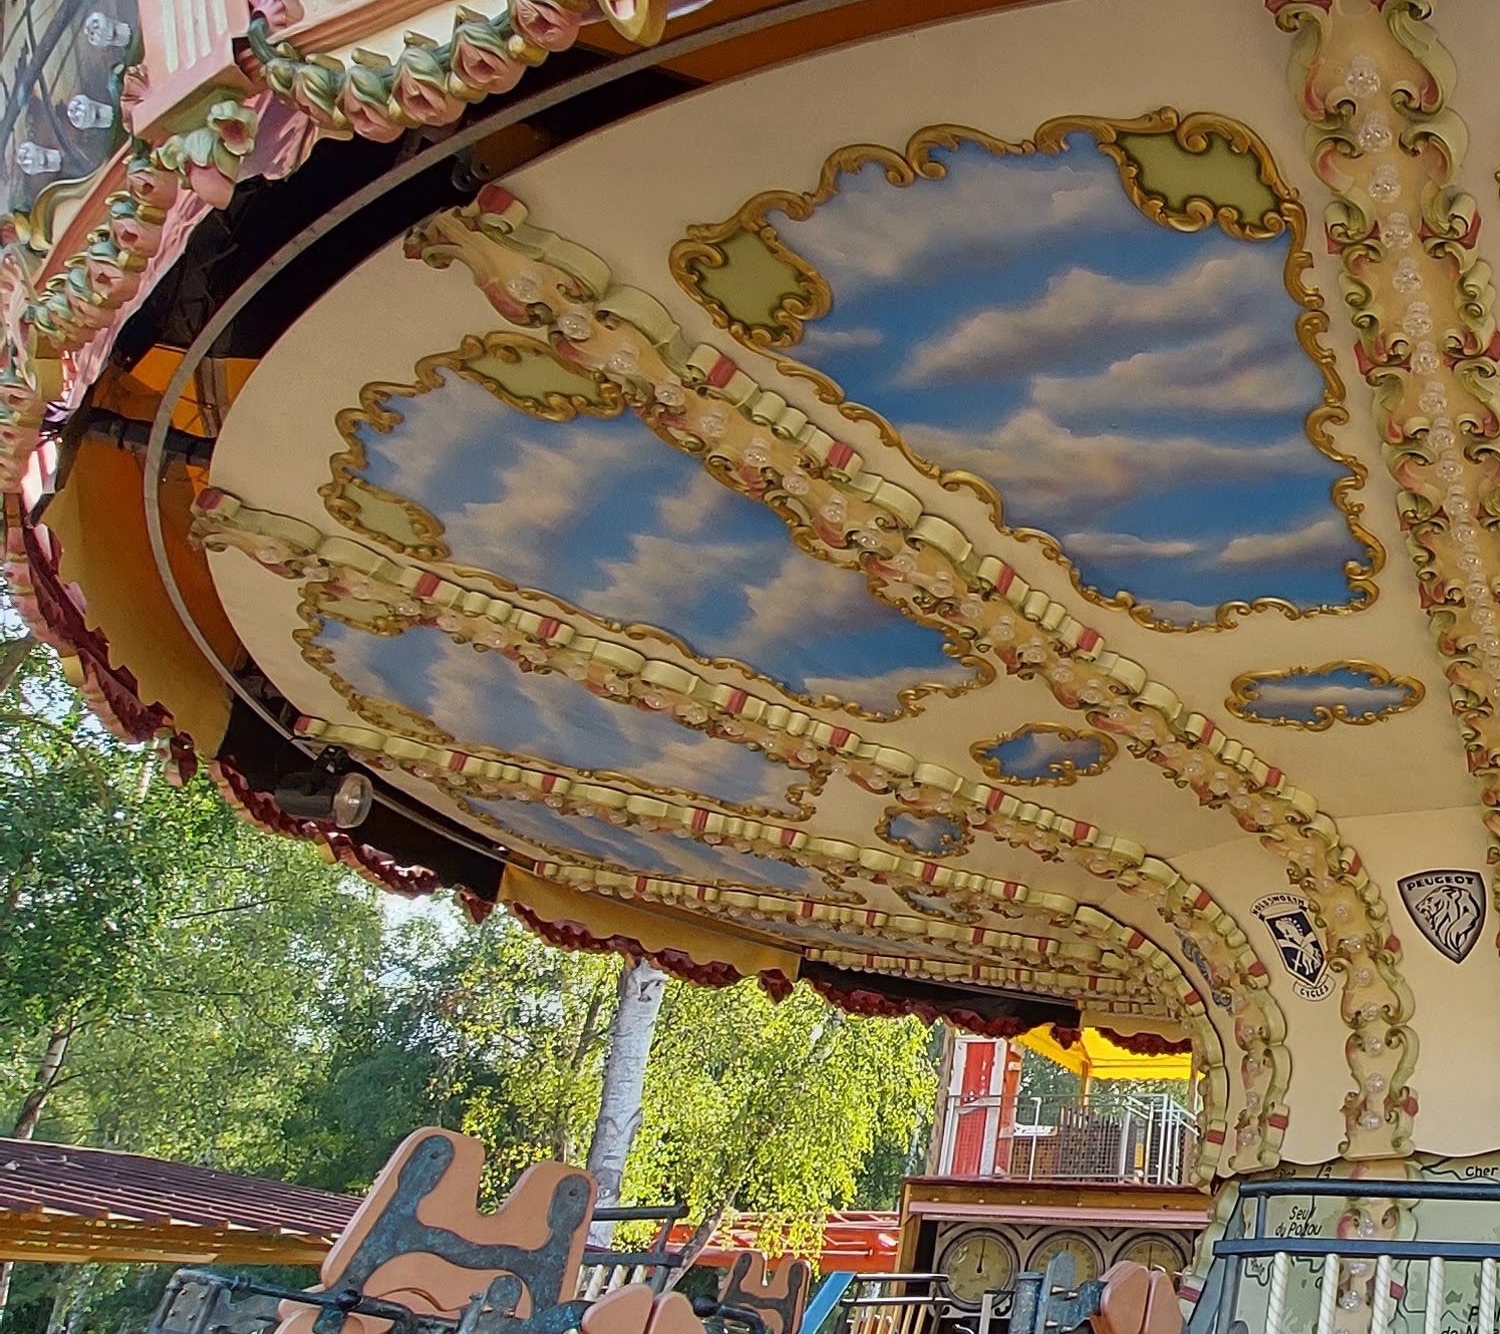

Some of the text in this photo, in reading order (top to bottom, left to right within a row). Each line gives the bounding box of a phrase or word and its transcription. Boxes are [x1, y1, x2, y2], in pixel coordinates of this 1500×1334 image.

[1406, 875, 1475, 891] PEUGEOT
[1300, 985, 1329, 998] CYCLES
[1465, 1166, 1499, 1177] Cher
